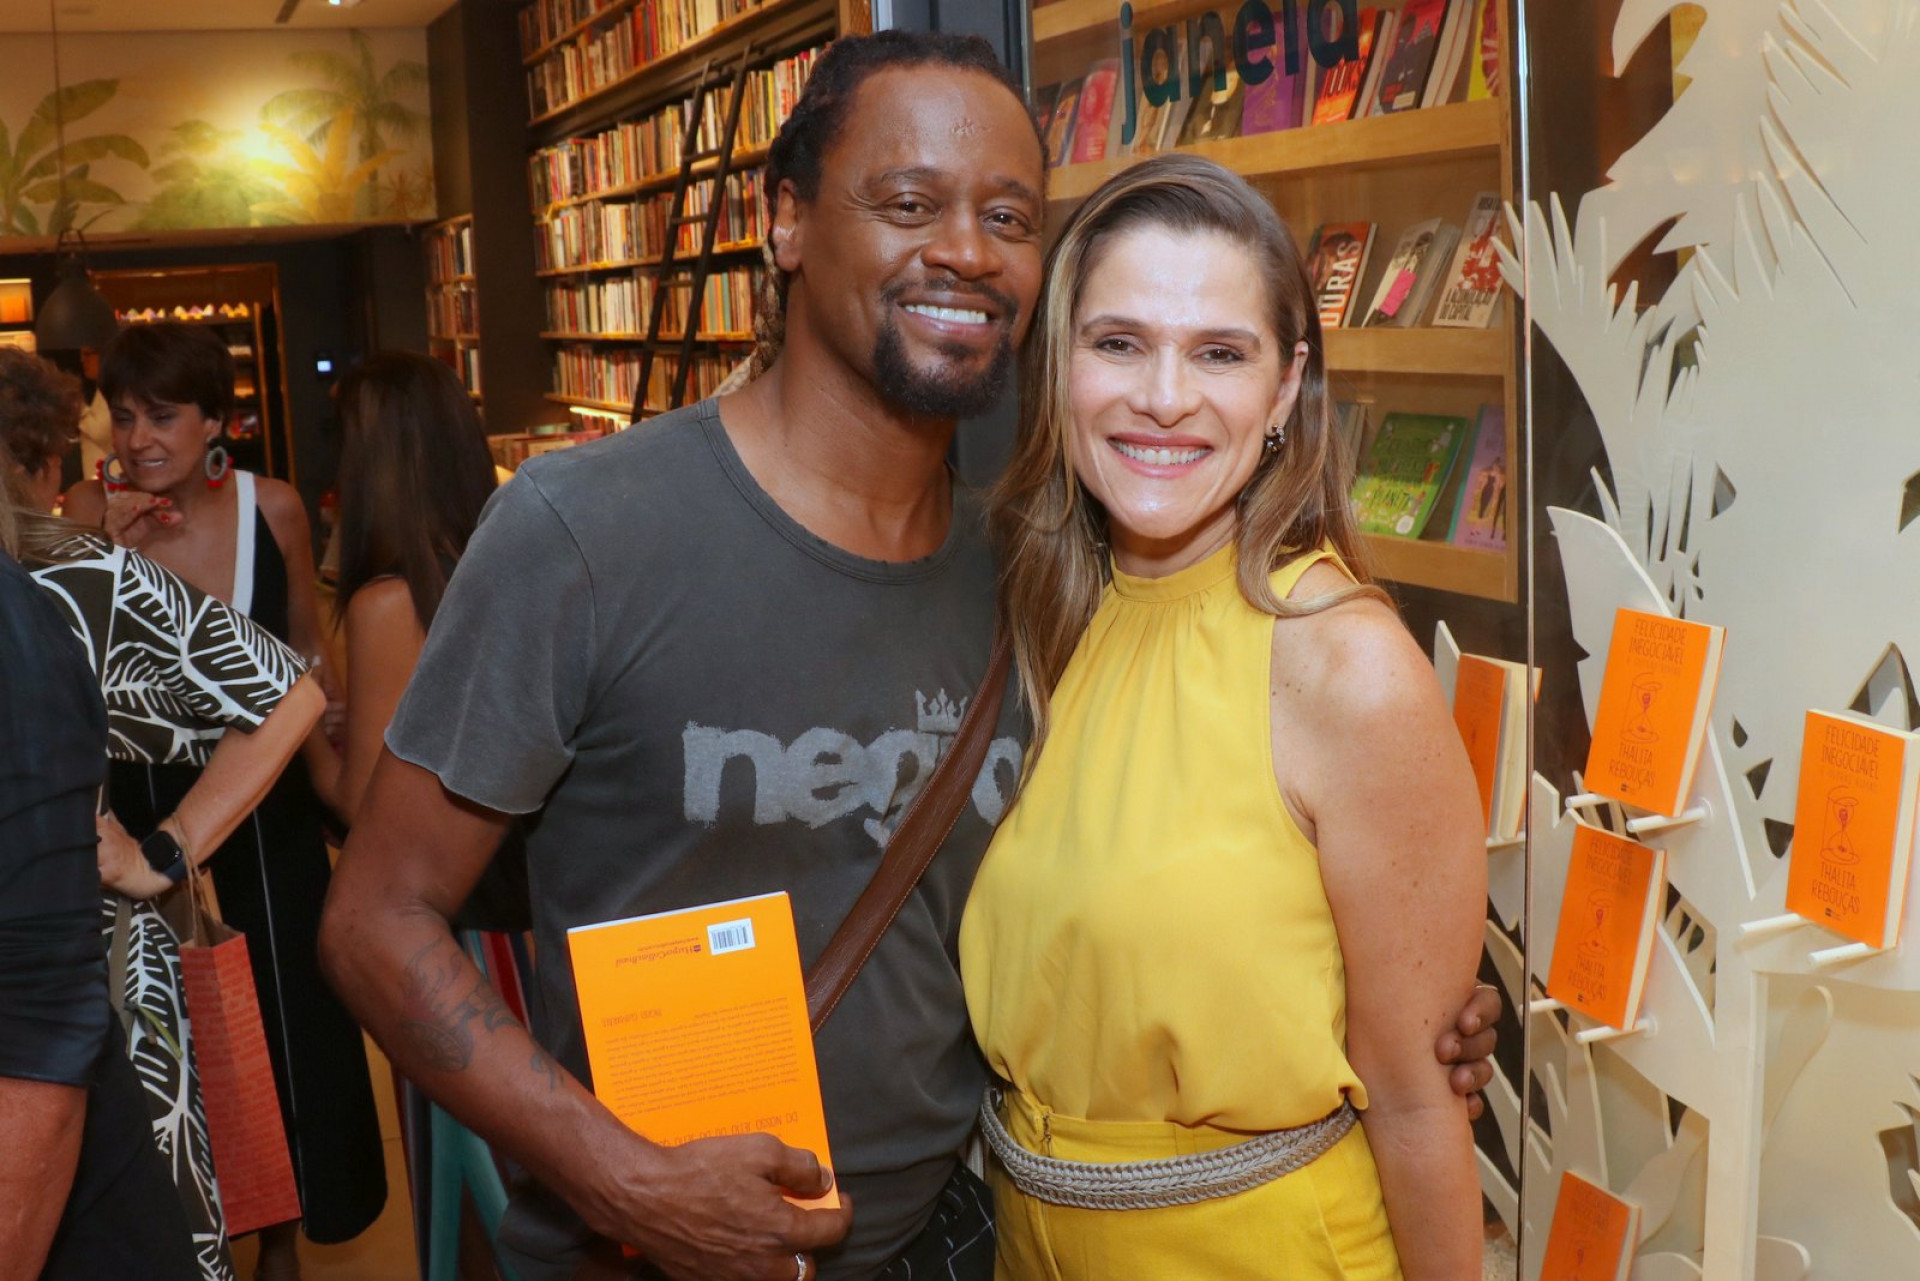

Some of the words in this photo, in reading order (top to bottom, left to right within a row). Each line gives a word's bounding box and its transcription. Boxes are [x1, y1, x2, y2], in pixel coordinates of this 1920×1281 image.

[1120, 0, 1359, 146] janela
[1634, 618, 1687, 645] FELICIDADE
[1618, 741, 1653, 769] THALITA
[1825, 723, 1881, 758] FELICIDADE
[1607, 758, 1657, 789] REBOUÇAS
[1820, 860, 1856, 891] THALITA
[1810, 878, 1861, 916] REBOUÇAS
